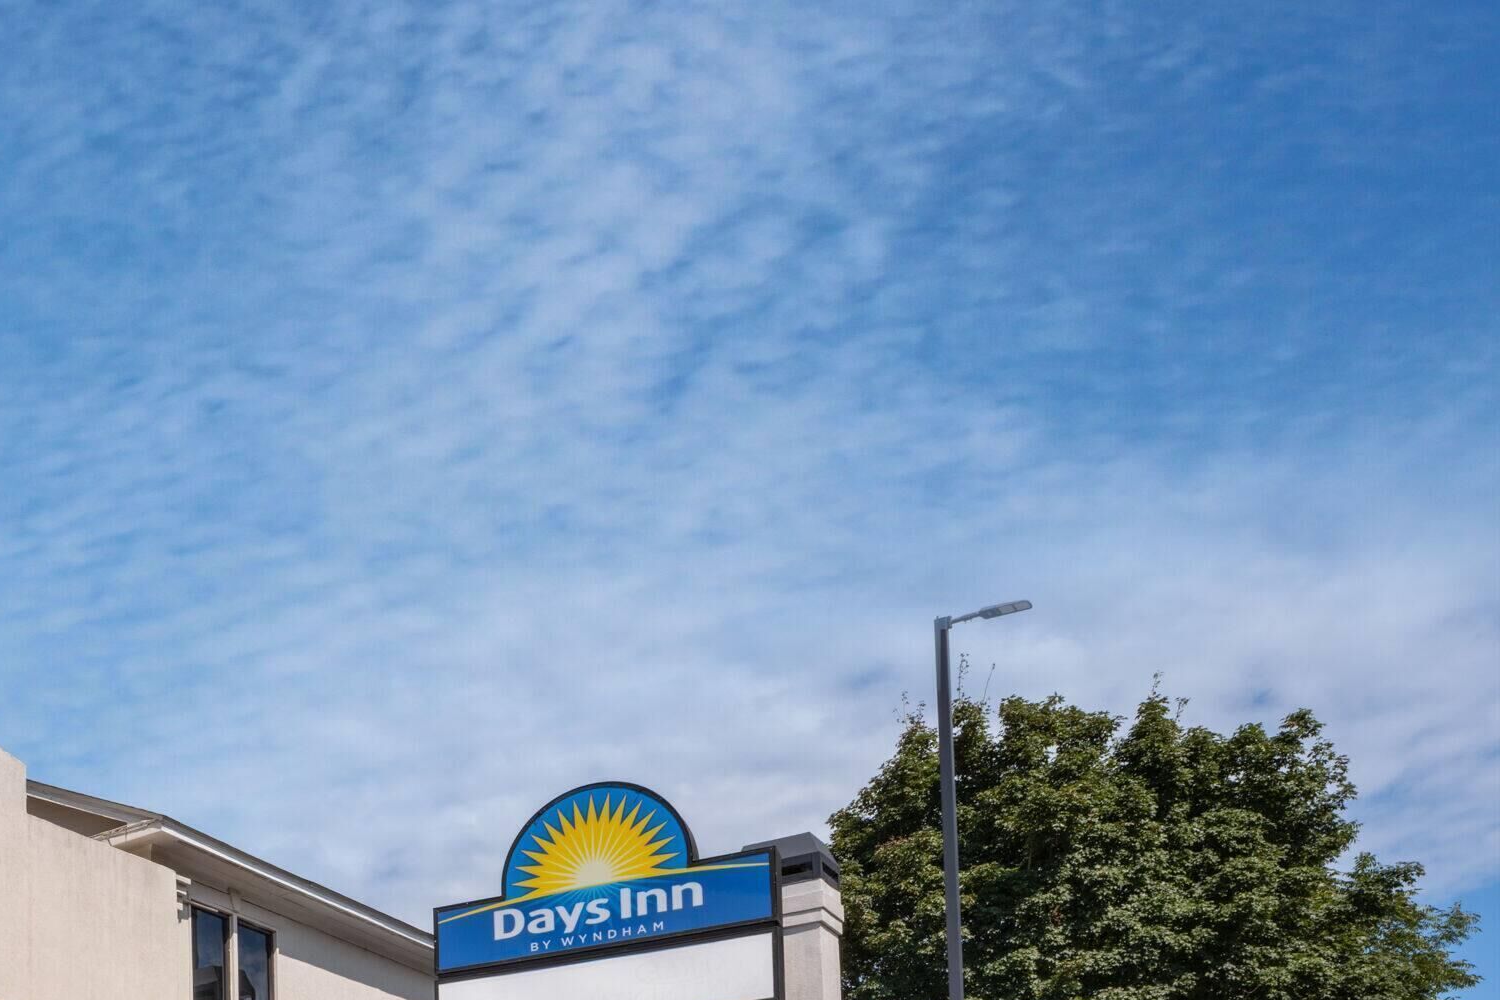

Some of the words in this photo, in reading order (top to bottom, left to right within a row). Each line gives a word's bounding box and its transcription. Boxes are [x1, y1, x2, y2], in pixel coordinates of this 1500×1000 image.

[493, 898, 611, 941] Days
[620, 881, 704, 919] Inn
[530, 940, 551, 952] BY
[561, 921, 664, 947] WYNDHAM
